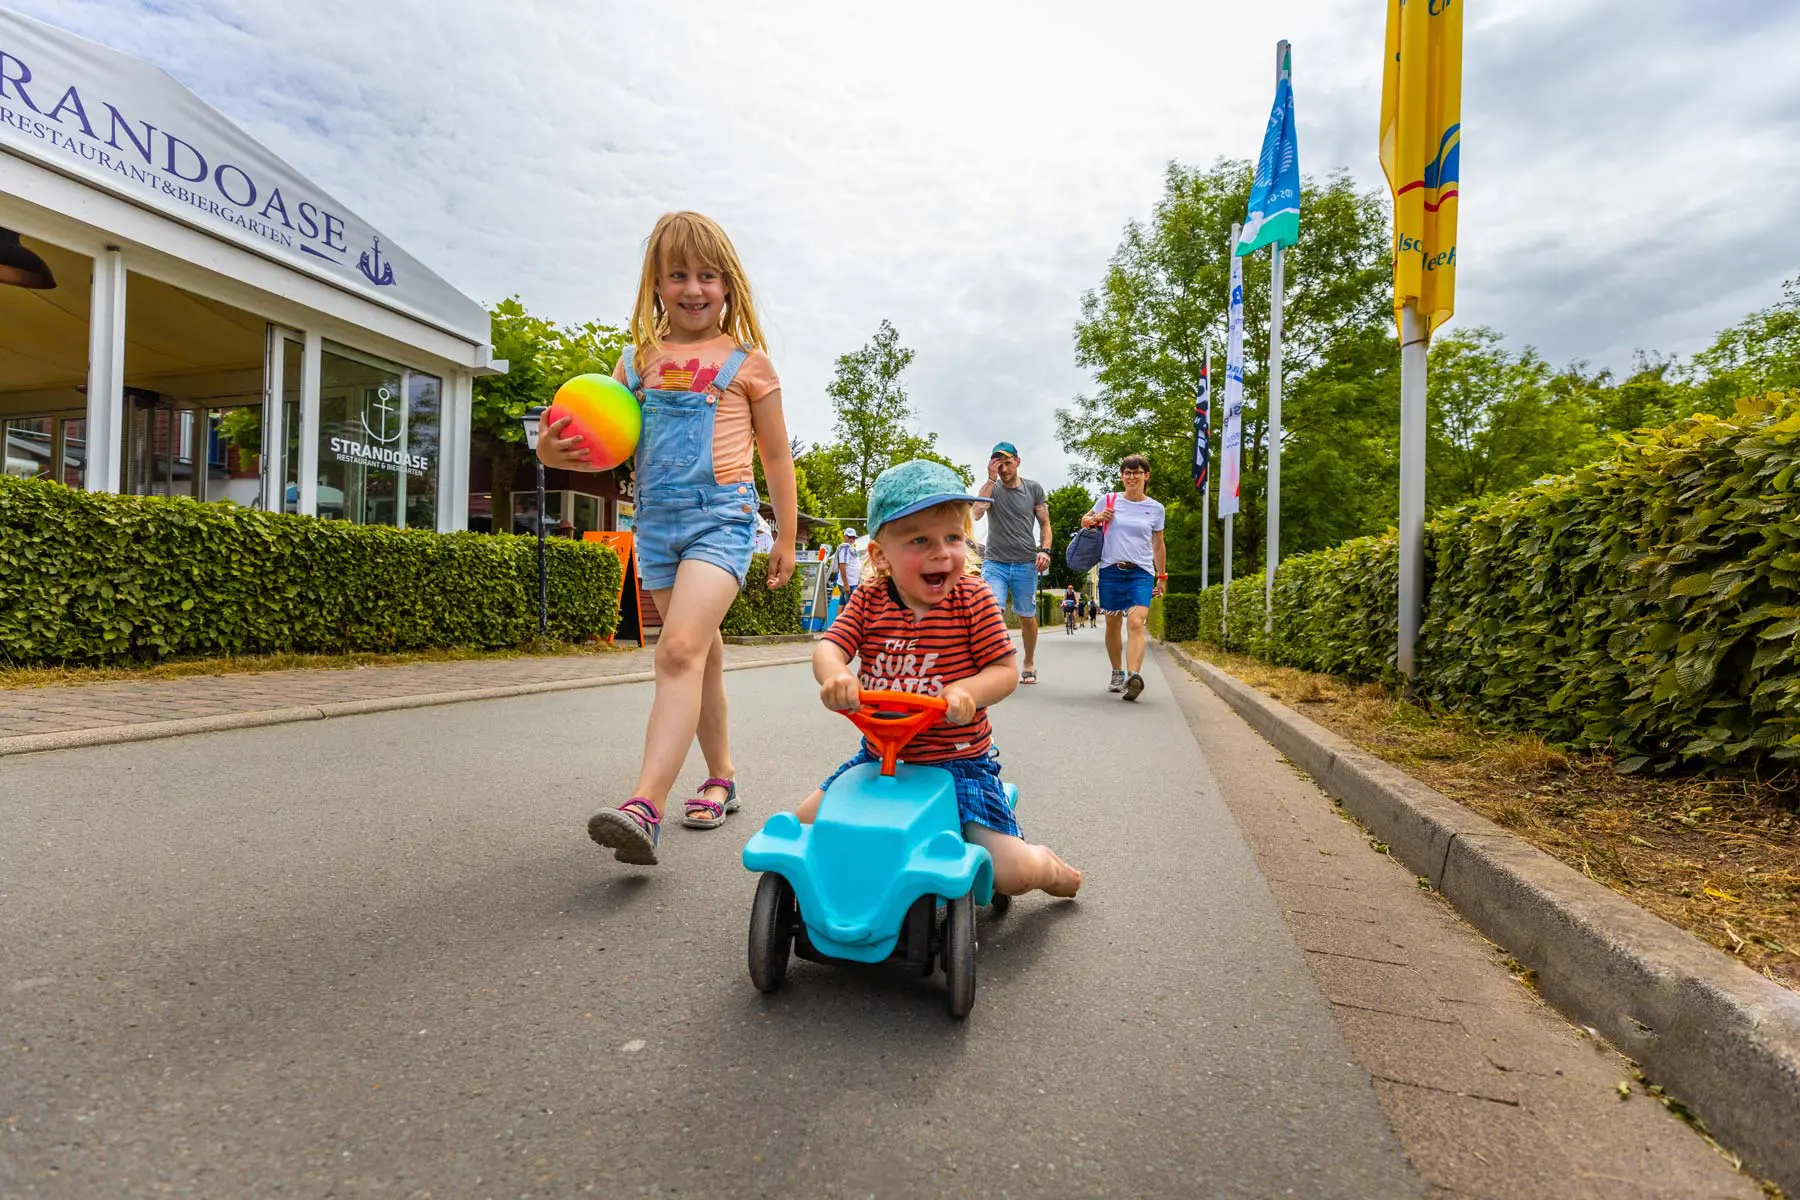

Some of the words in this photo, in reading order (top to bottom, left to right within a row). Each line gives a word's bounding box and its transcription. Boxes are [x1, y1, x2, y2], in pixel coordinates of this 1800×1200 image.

[330, 437, 429, 471] STRANDOASE
[336, 453, 380, 469] RESTAURANT
[380, 462, 386, 470] &
[386, 463, 423, 477] BIERGARTEN
[883, 638, 919, 652] THE
[871, 651, 939, 678] SURF
